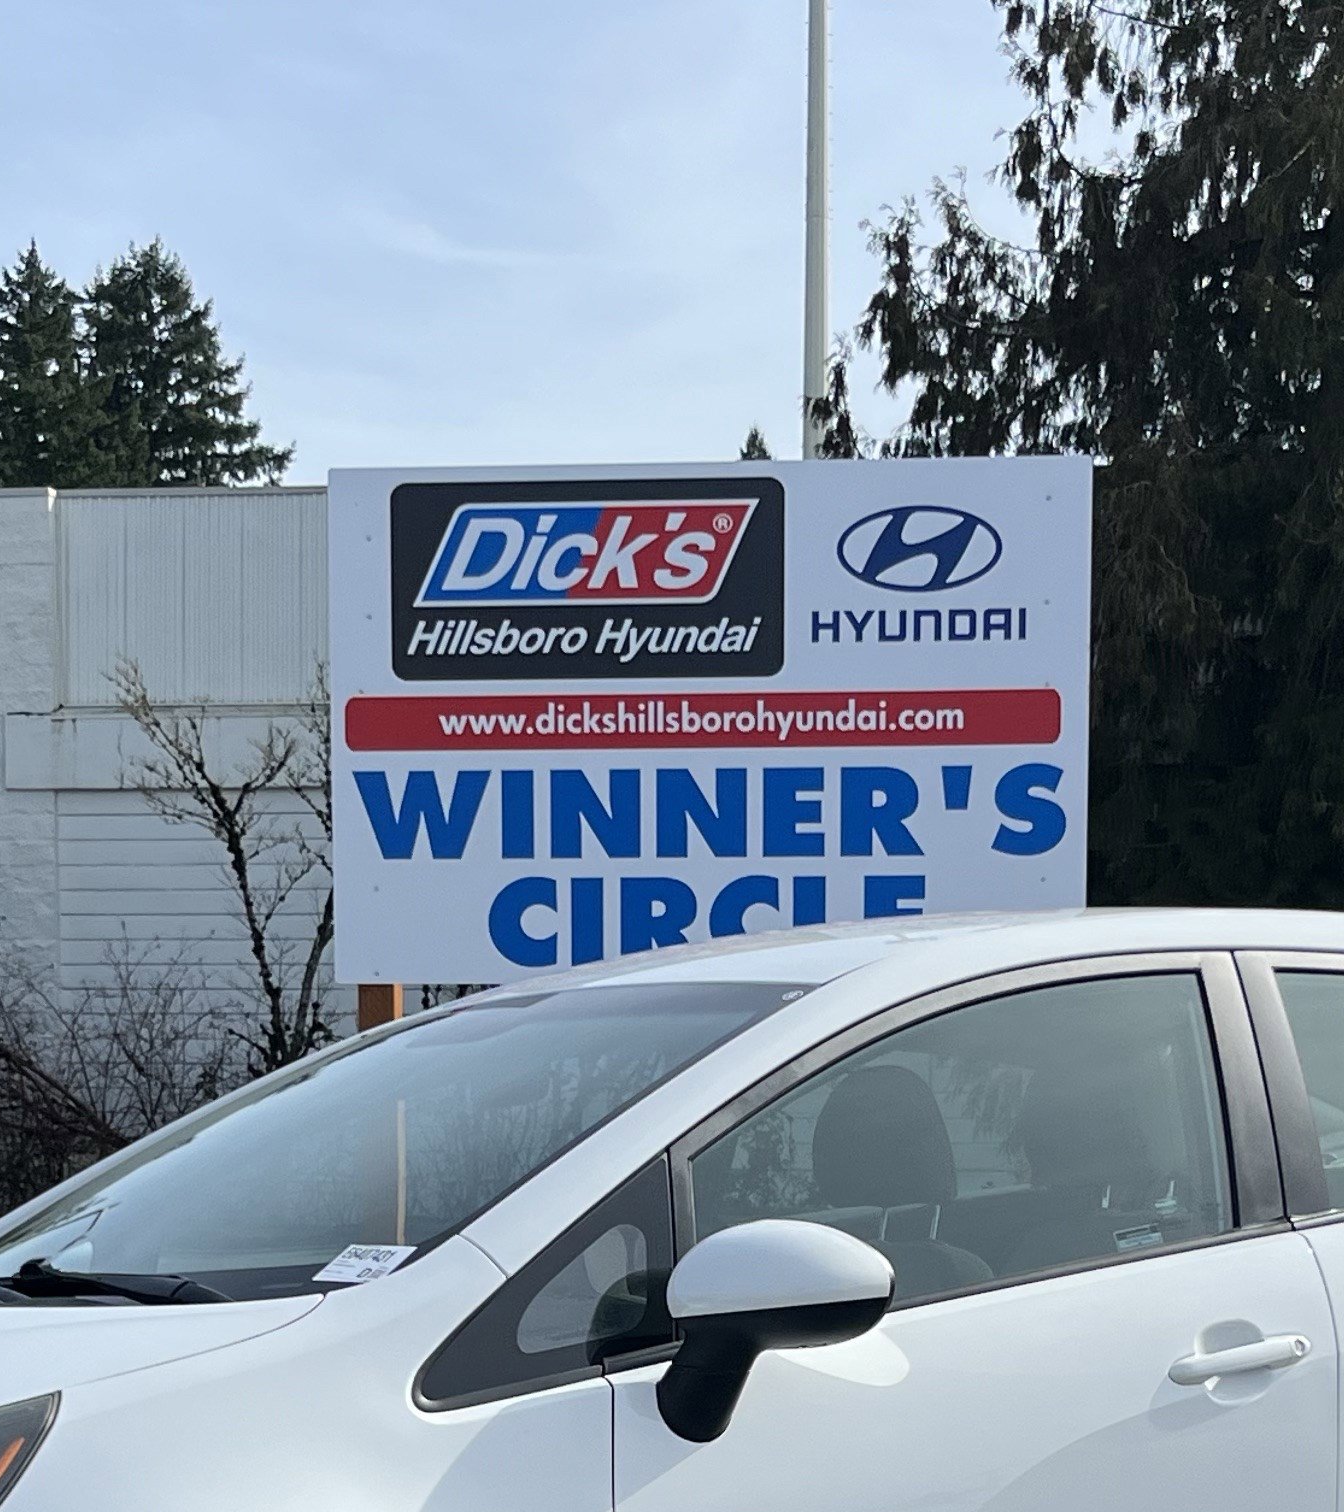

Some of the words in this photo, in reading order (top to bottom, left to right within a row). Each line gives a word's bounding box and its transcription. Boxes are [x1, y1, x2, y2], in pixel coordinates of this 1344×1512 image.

[442, 512, 717, 590] Dick's
[407, 619, 585, 656] Hillsboro
[594, 617, 762, 663] Hyundai
[811, 608, 1027, 643] HYUNDAI
[438, 700, 965, 740] www.dickshillsborohyundai.com
[352, 764, 1068, 861] WINNER'S
